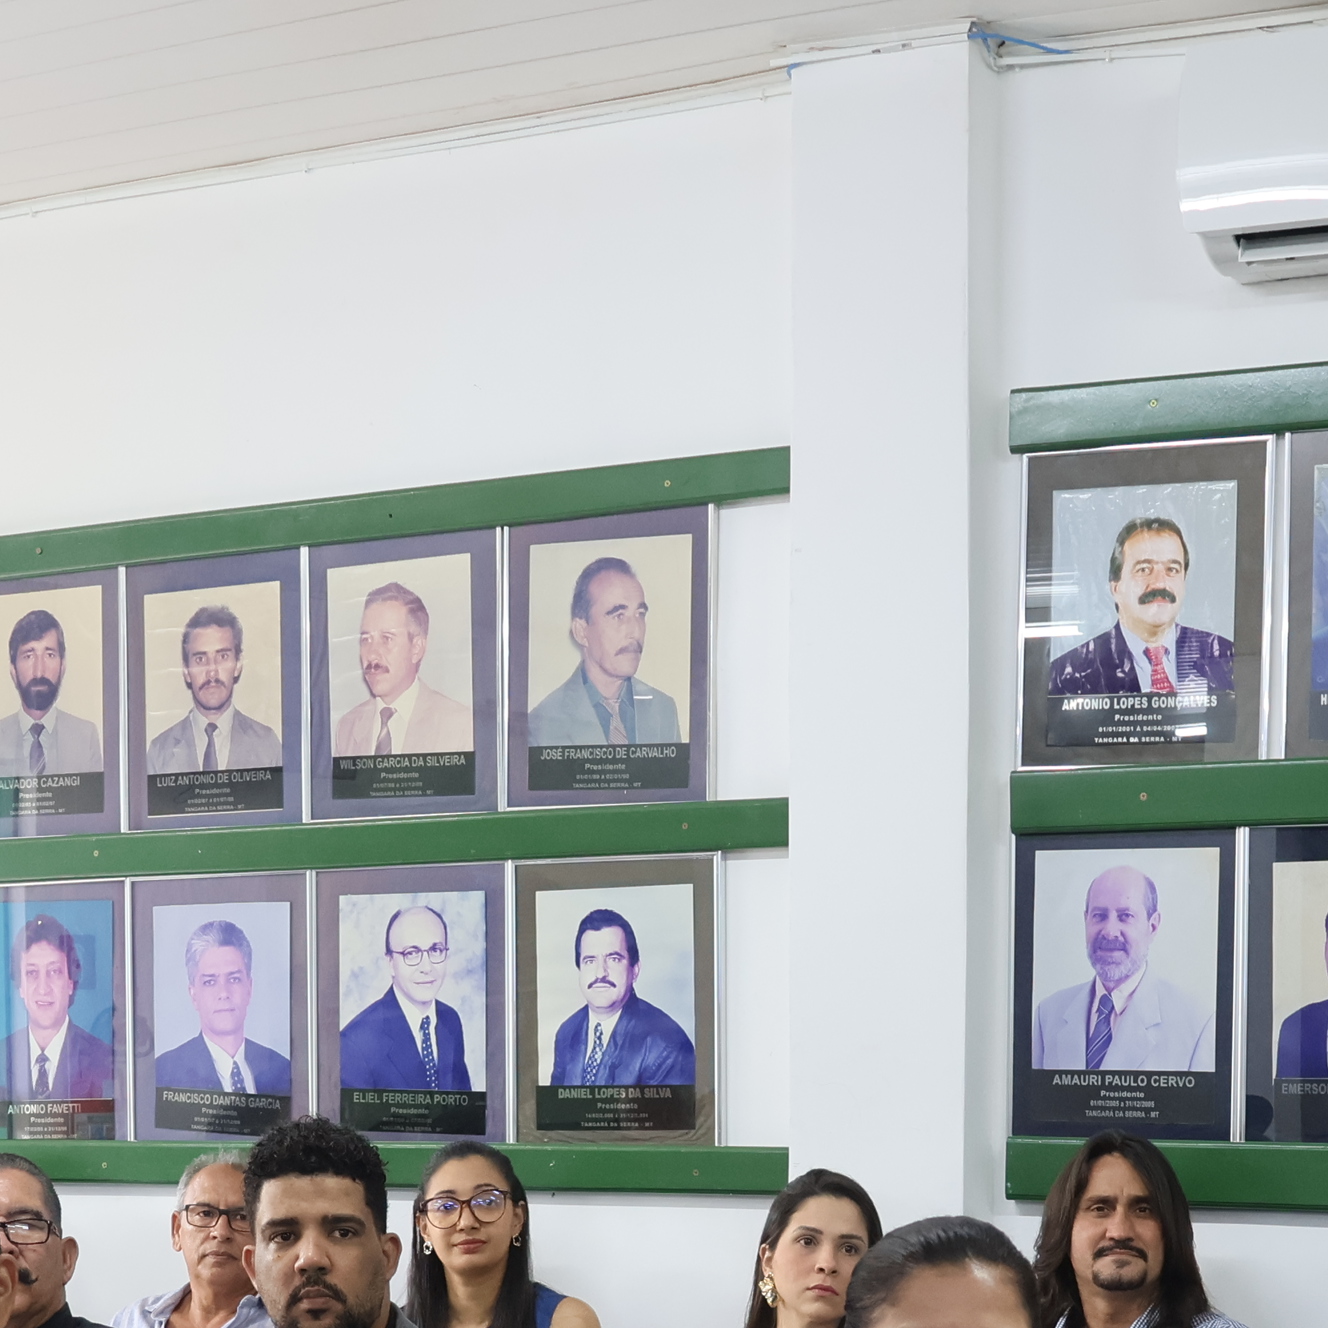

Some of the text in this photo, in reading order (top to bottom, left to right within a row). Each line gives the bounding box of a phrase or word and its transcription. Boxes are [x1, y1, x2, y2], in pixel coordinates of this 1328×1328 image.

[1061, 695, 1218, 711] ANTONIO LOPES GONÇALVES
[1114, 713, 1162, 722] Presidente
[1098, 725, 1134, 733] 01/01/2001
[1094, 735, 1127, 744] TANGARÁ
[1129, 736, 1139, 744] DA
[540, 746, 677, 760] JOSÉ FRANCISCO DE CARVALHO
[339, 754, 466, 770] WILSON GARCIA DA SILVEIRA
[157, 770, 272, 787] LUIZ ANTONIO DE OLIVEIRA
[380, 771, 420, 779] Presidente
[40, 775, 80, 788] CAZANGI
[18, 791, 53, 799] Presidente
[194, 787, 231, 795] Presidente
[1052, 1074, 1195, 1088] AMAURI PAULO CERVO
[353, 1091, 469, 1106] ELIEL FERREIRA PORTO
[558, 1087, 673, 1099] DANIEL LOPES DA SILVA
[1100, 1090, 1145, 1098] Presidente
[162, 1090, 281, 1110] FRANCISCO DANTAS GARCIA
[7, 1103, 82, 1115] ANTONIO FAVETTI
[390, 1106, 430, 1115] Presidente
[597, 1102, 639, 1110] Presidente
[1085, 1109, 1146, 1119] TANGARÁ DA SERRA
